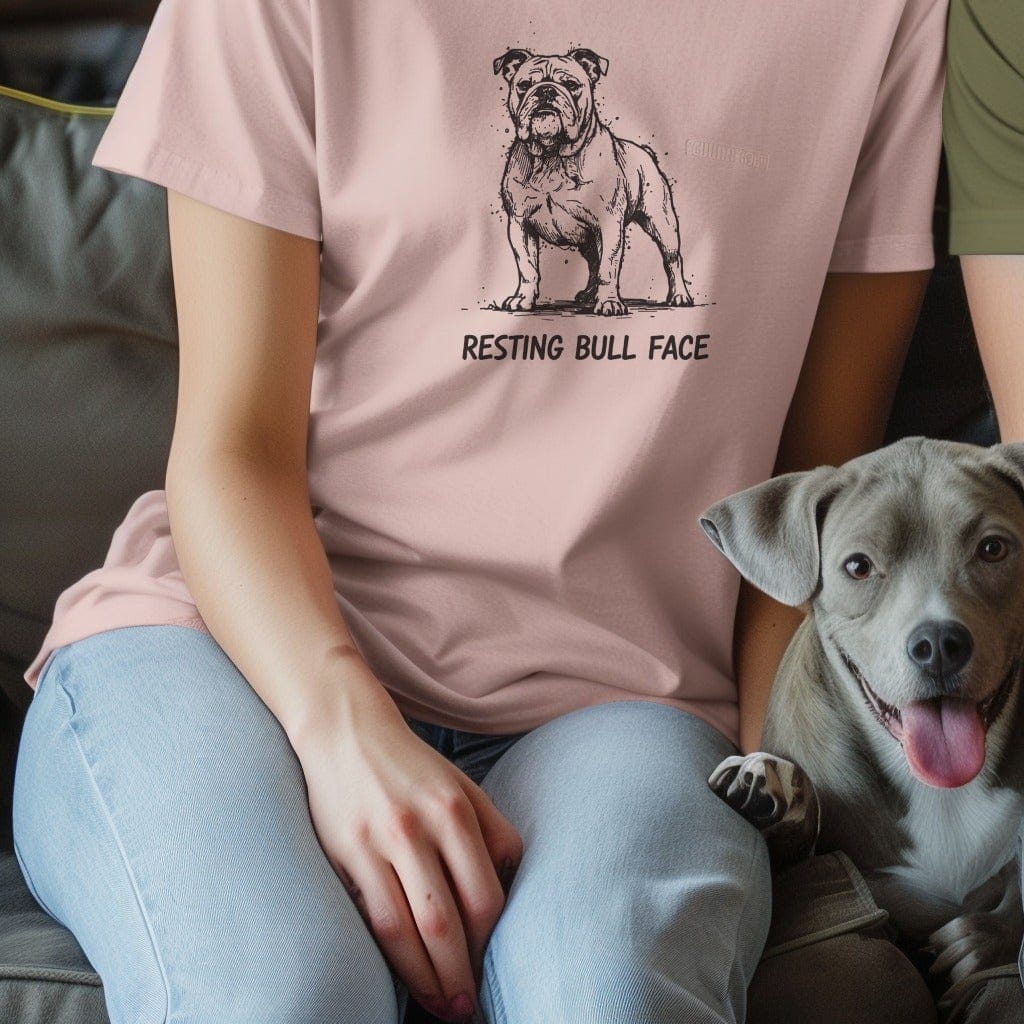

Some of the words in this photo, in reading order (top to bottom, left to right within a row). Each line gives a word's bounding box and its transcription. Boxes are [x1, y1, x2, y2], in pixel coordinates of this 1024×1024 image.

[462, 333, 564, 360] RESTING
[575, 334, 636, 360] BULL
[648, 334, 711, 360] FACE
